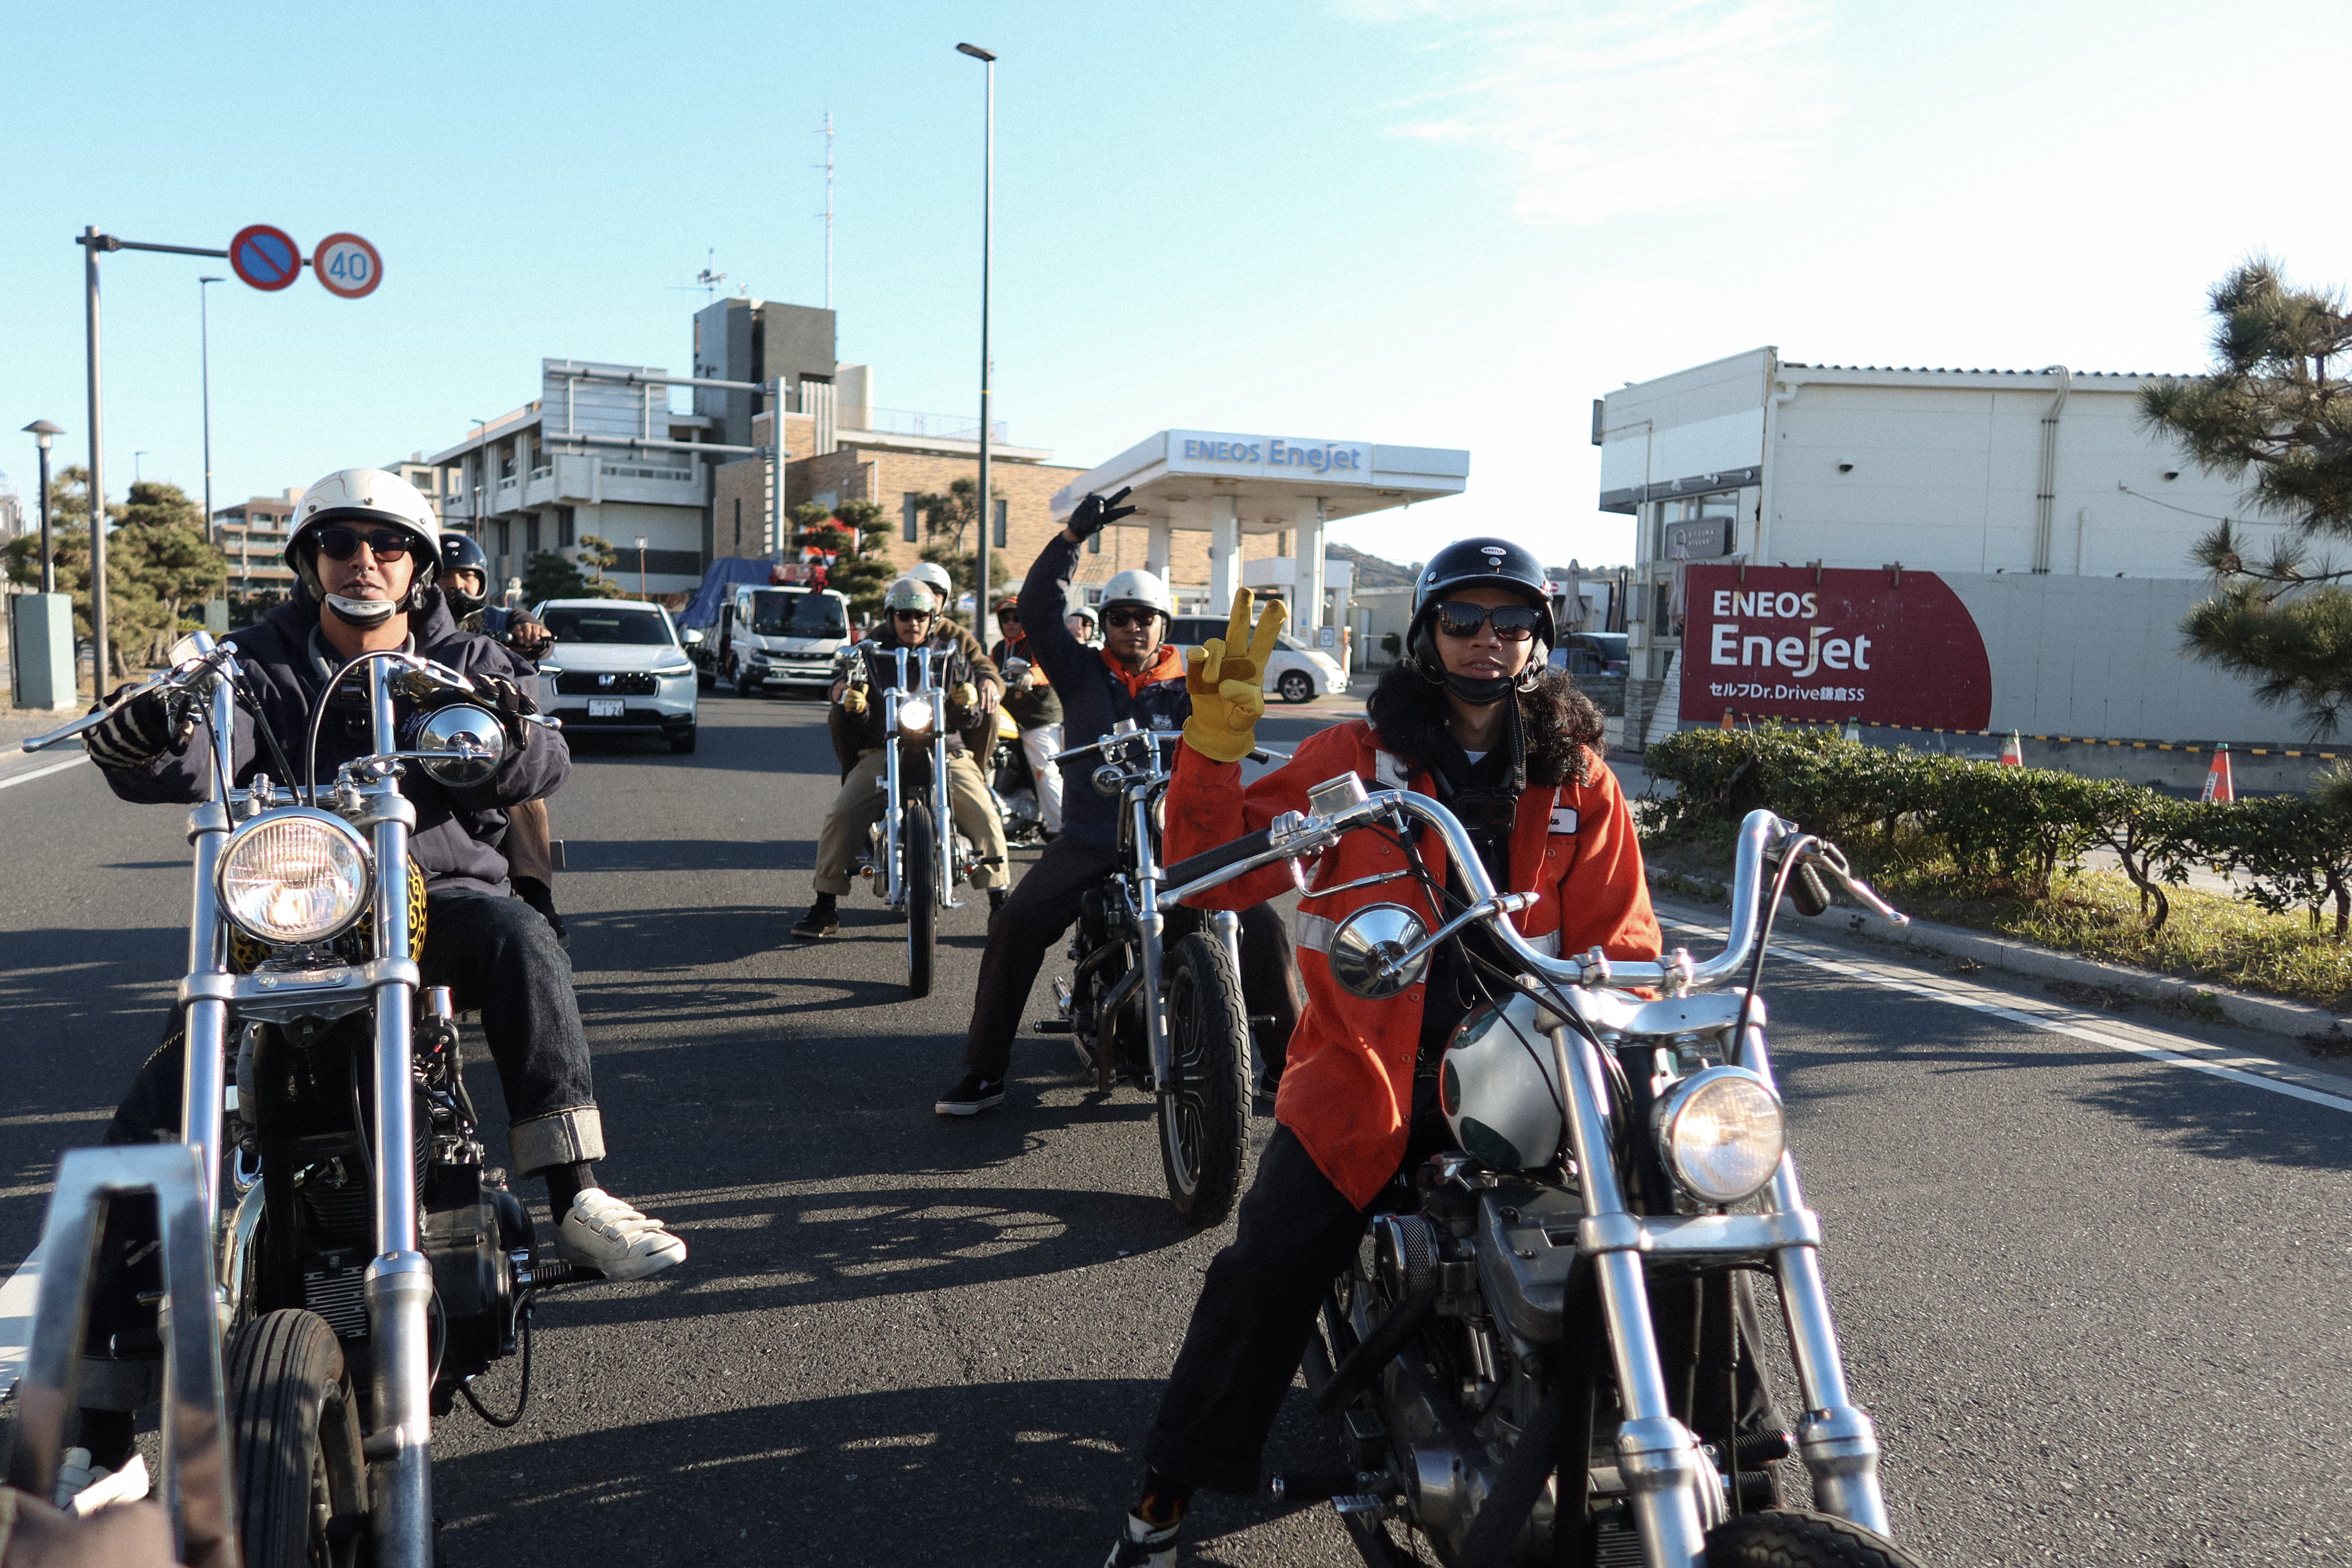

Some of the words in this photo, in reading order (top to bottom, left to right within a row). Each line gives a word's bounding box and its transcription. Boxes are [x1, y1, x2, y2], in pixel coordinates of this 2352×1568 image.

[330, 251, 367, 281] 40
[1185, 440, 1261, 463] ENEOS
[1270, 439, 1361, 473] Enejet
[1713, 590, 1818, 619] ENEOS
[1711, 624, 1872, 677] Enejet
